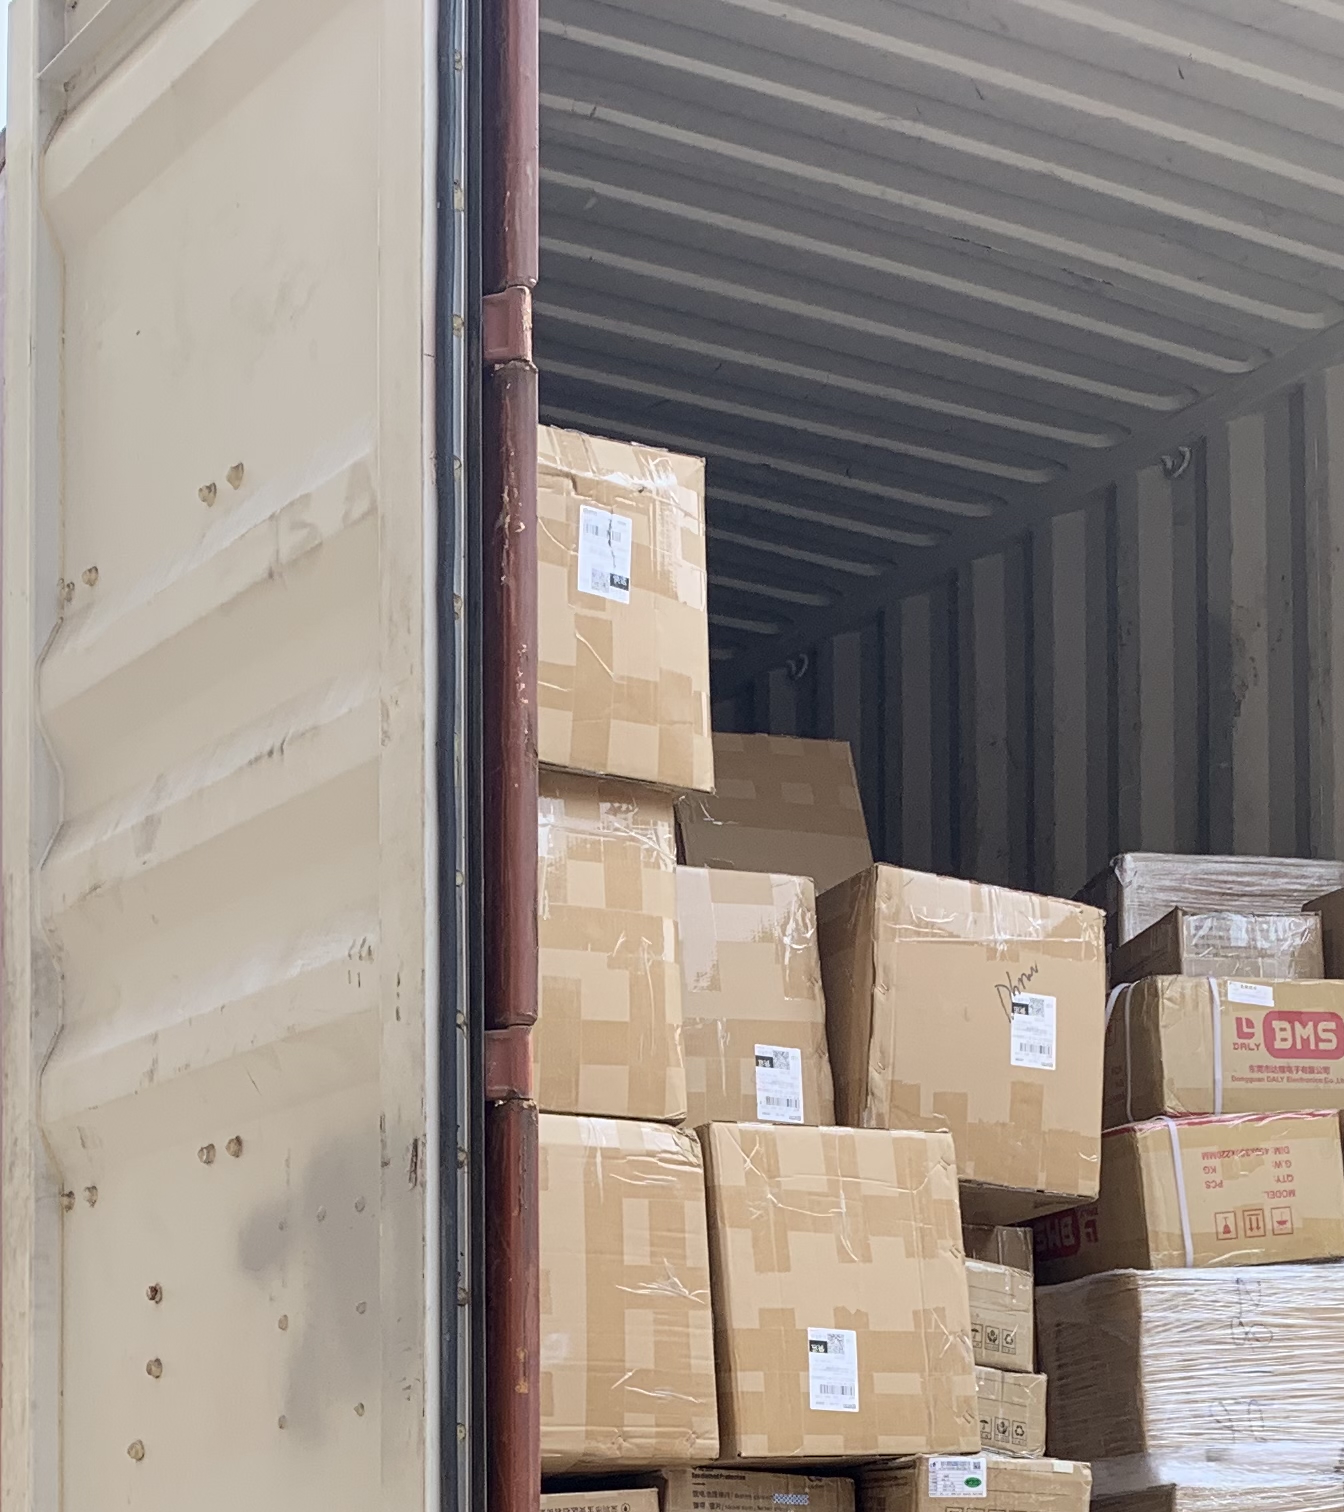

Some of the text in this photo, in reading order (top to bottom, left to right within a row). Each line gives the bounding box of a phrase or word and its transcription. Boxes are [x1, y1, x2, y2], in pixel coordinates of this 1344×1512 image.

[1272, 1020, 1337, 1050] BMS
[1233, 1042, 1261, 1051] DALY
[1202, 1165, 1217, 1174] KG
[1205, 1180, 1224, 1189] PCS
